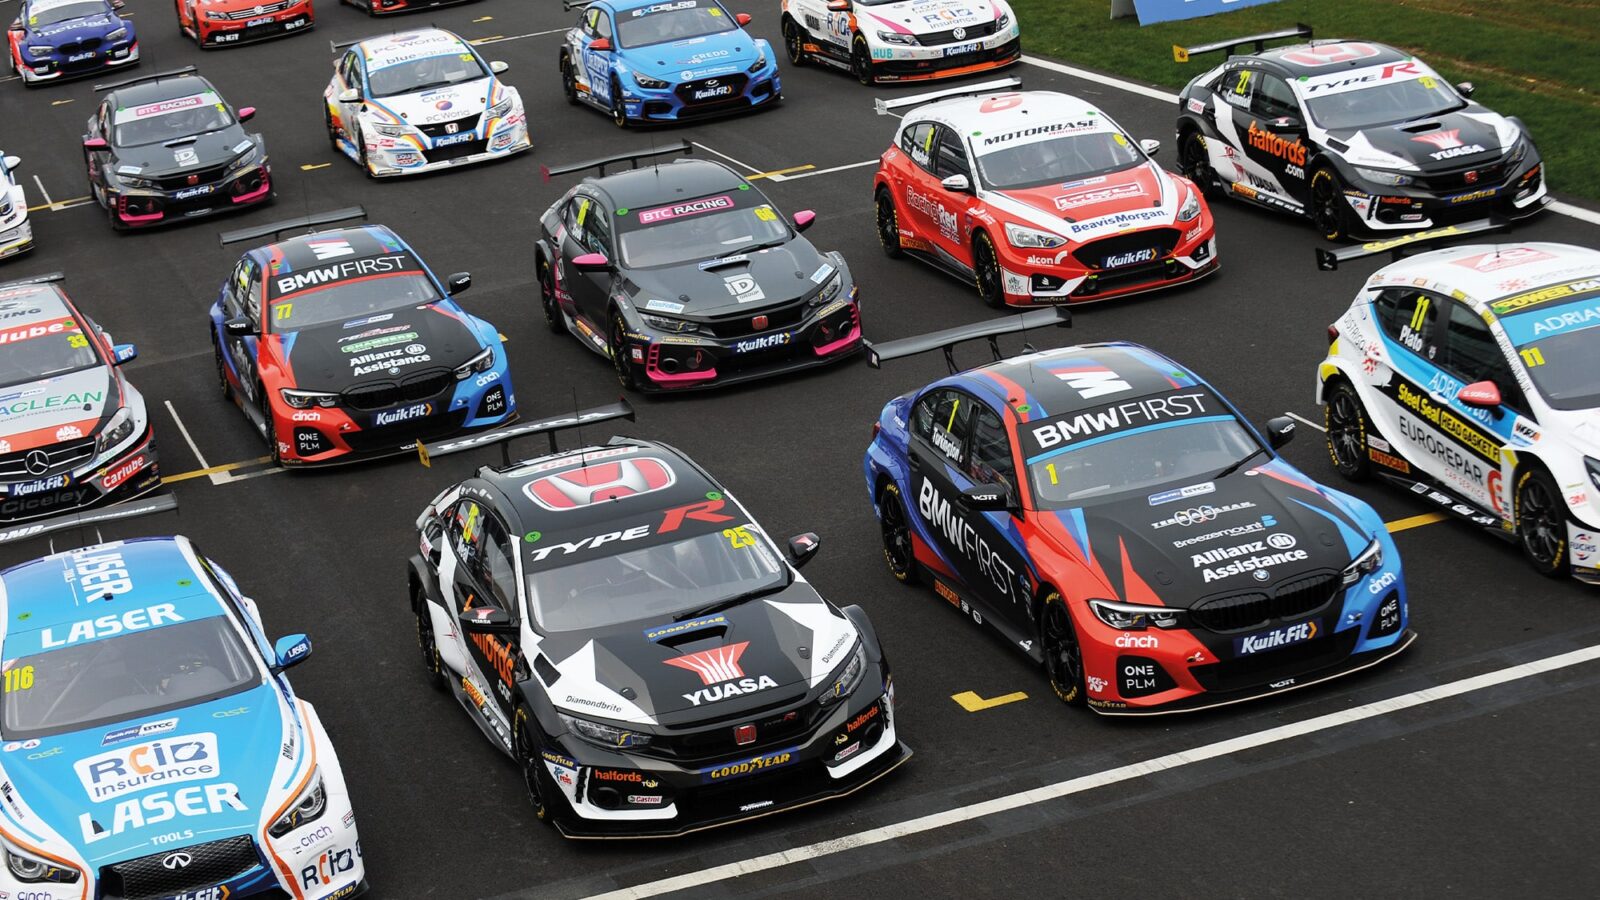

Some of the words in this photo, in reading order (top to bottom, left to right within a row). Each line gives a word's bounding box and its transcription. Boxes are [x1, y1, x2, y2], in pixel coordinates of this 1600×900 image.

[692, 50, 729, 60] CREDO
[873, 48, 893, 59] HUB
[1236, 70, 1252, 95] 27
[1307, 74, 1377, 93] TYPE
[1381, 62, 1422, 79] R
[137, 105, 158, 116] BTC
[159, 98, 197, 111] RACING
[985, 120, 1098, 146] MOTORBASE
[1430, 144, 1486, 160] YUASA
[643, 208, 672, 222] BTC
[674, 198, 727, 216] RACING
[276, 304, 292, 319] 77
[1410, 296, 1430, 332] 11
[67, 334, 89, 349] 33
[1400, 325, 1423, 352] Plato
[350, 349, 404, 366] Allianz
[353, 353, 431, 376] Assistance
[1519, 347, 1545, 368] 11
[476, 371, 500, 387] cinch
[486, 391, 502, 403] ONE
[487, 402, 503, 413] PLM
[1398, 383, 1422, 411] Steel
[1420, 399, 1441, 425] Seal
[292, 410, 320, 421] cinch
[298, 432, 319, 441] ONE
[300, 442, 320, 450] PLM
[932, 425, 960, 463] Turkington
[540, 447, 629, 471] Castrol
[1399, 415, 1485, 488] EUROREPAR
[103, 456, 145, 487] Carlube
[1045, 463, 1059, 485] 1
[0, 489, 89, 514] Ciceley
[1569, 494, 1587, 505] 3M
[657, 500, 736, 534] R
[531, 524, 650, 562] TYPE
[723, 527, 756, 549] 25
[1172, 521, 1263, 549] Breezemount
[1190, 540, 1268, 568] Allianz
[1570, 541, 1597, 553] FUCHS
[1202, 548, 1309, 583] Assistance
[1368, 570, 1397, 596] cinch
[1380, 599, 1398, 618] ONE
[41, 603, 185, 649] LASER
[647, 616, 726, 639] GOODYEAR
[1381, 612, 1399, 631] PLM
[287, 643, 308, 658] LASER
[822, 632, 851, 664] Diamondbrite
[1115, 632, 1159, 648] cinch
[4, 665, 35, 693] 116
[1124, 665, 1155, 677] ONE
[682, 675, 780, 706] YUASA
[1126, 678, 1156, 689] PLM
[566, 694, 623, 713] Diamondbrite
[143, 720, 175, 732] BTCC
[847, 706, 879, 732] halfords
[542, 751, 574, 767] GOODYEAR
[711, 752, 791, 779] GOODYEAR
[95, 764, 213, 798] Insurance
[594, 769, 642, 782] halfords
[78, 783, 249, 845] LASER
[151, 830, 194, 846] TOOLS
[300, 825, 333, 847] cinch
